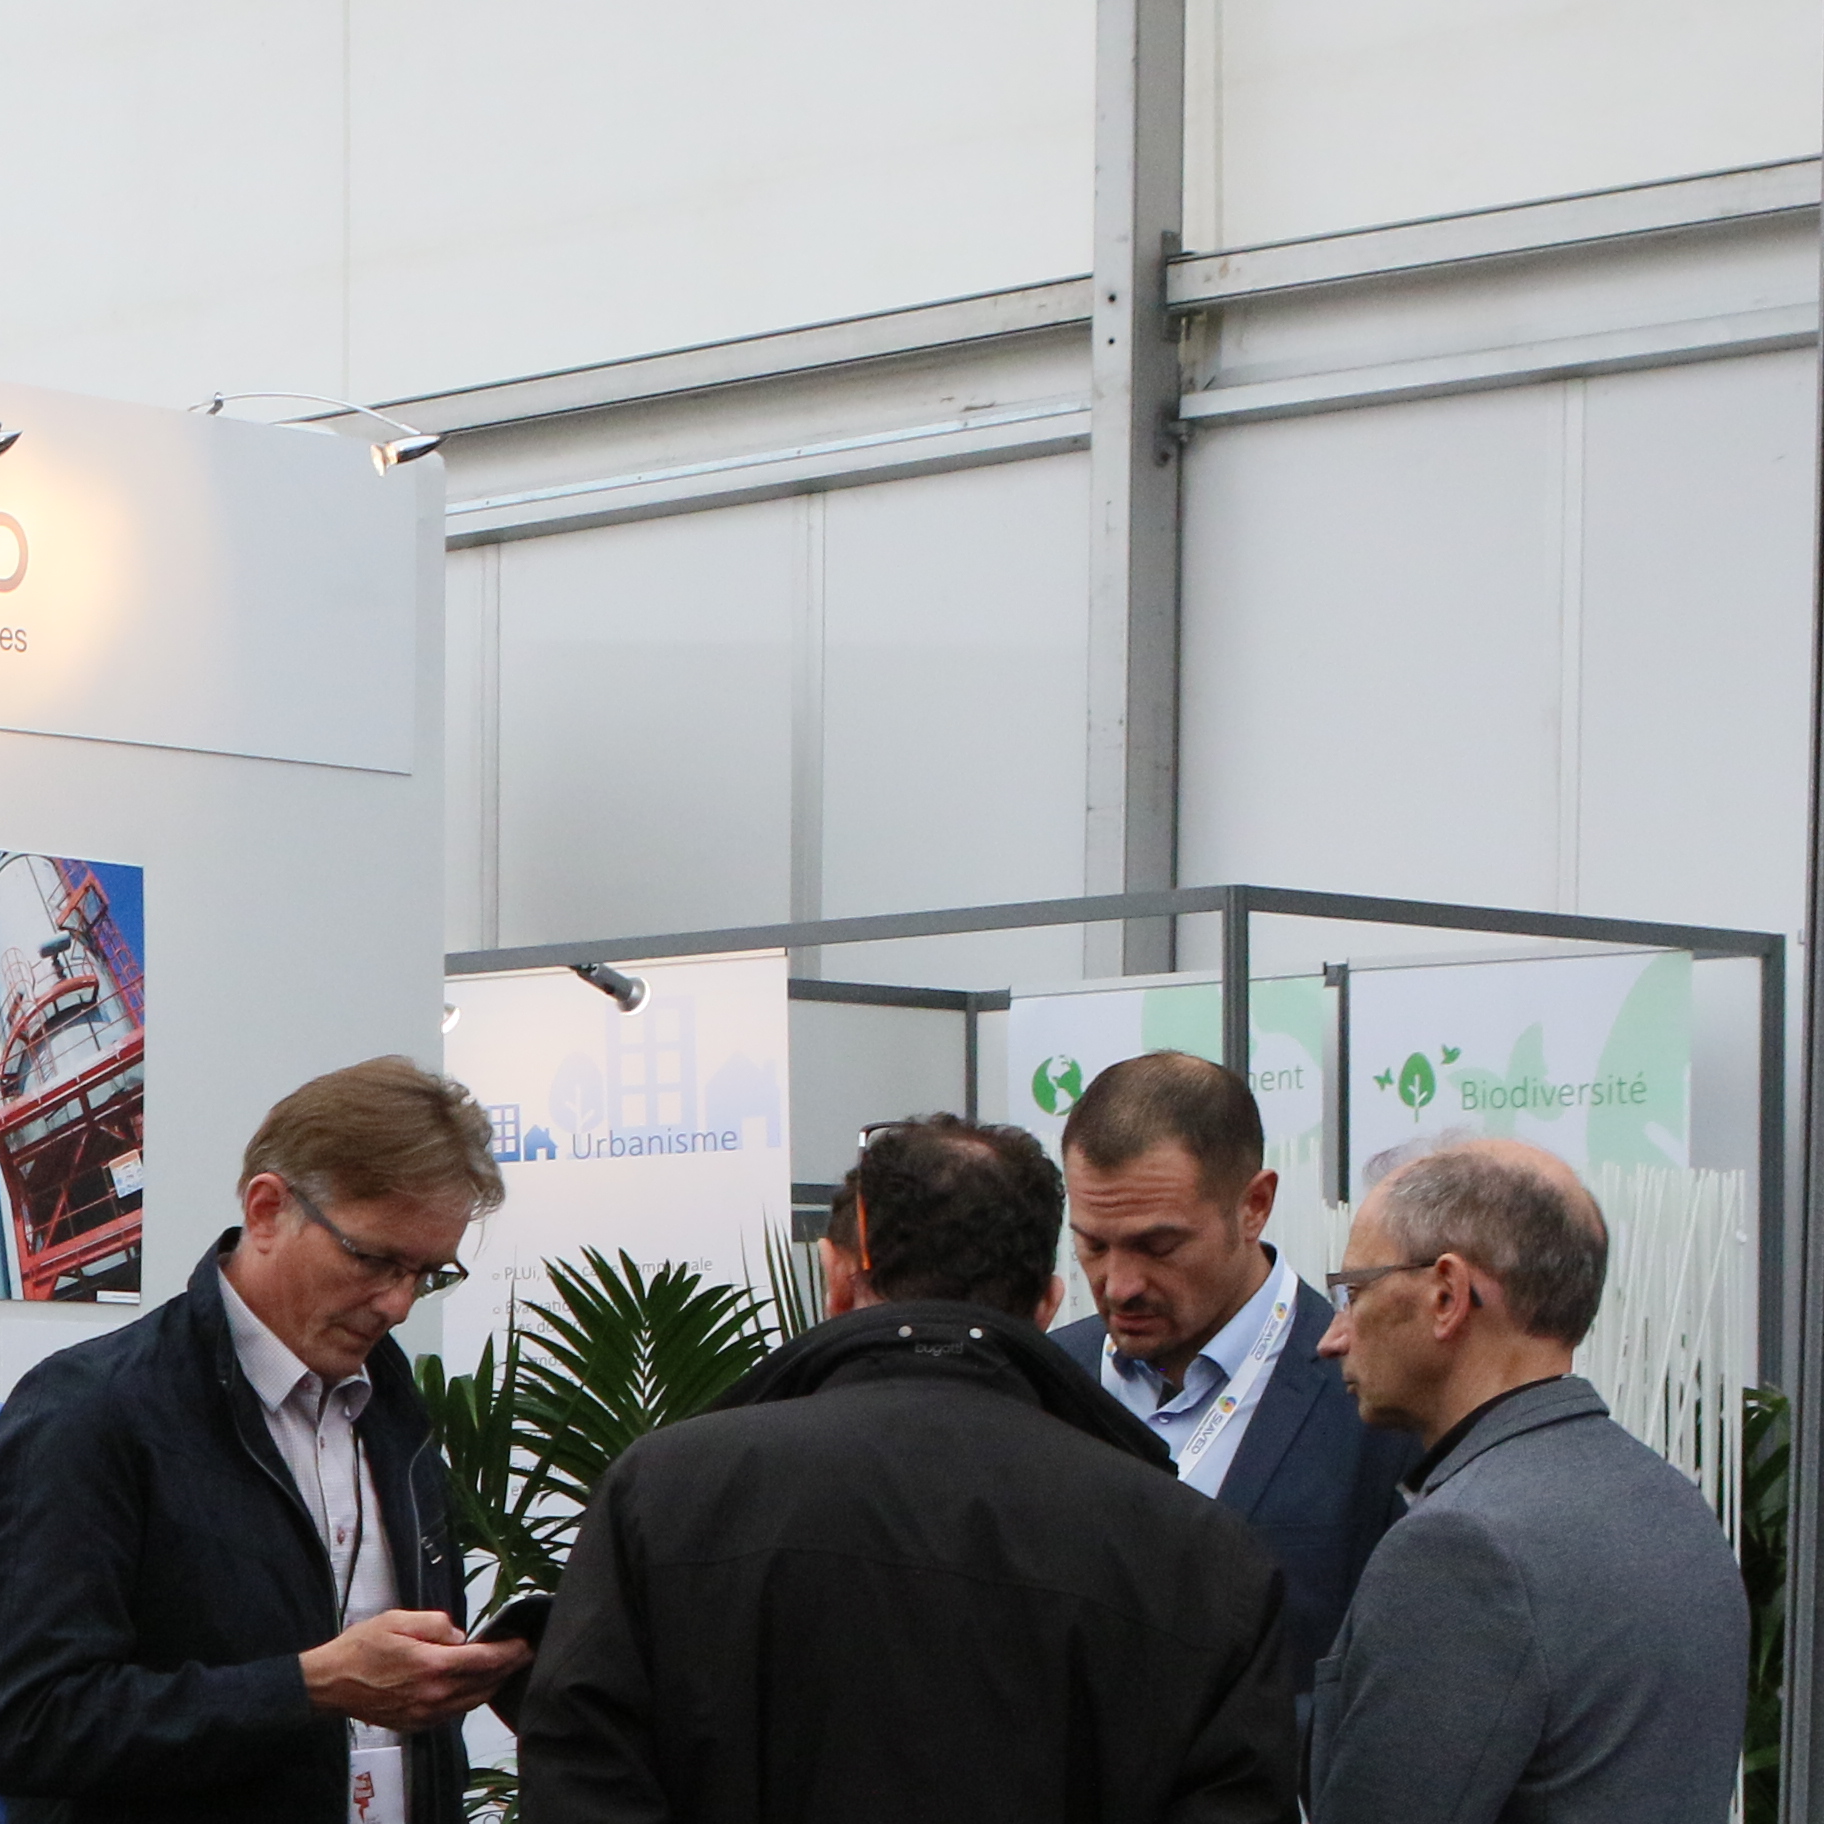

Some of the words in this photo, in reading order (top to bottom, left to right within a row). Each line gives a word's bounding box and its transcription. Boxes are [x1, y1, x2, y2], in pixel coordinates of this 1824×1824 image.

[1461, 1071, 1648, 1112] Biodiversité
[572, 1128, 738, 1160] Urbanisme
[1191, 1412, 1223, 1455] SIAVED
